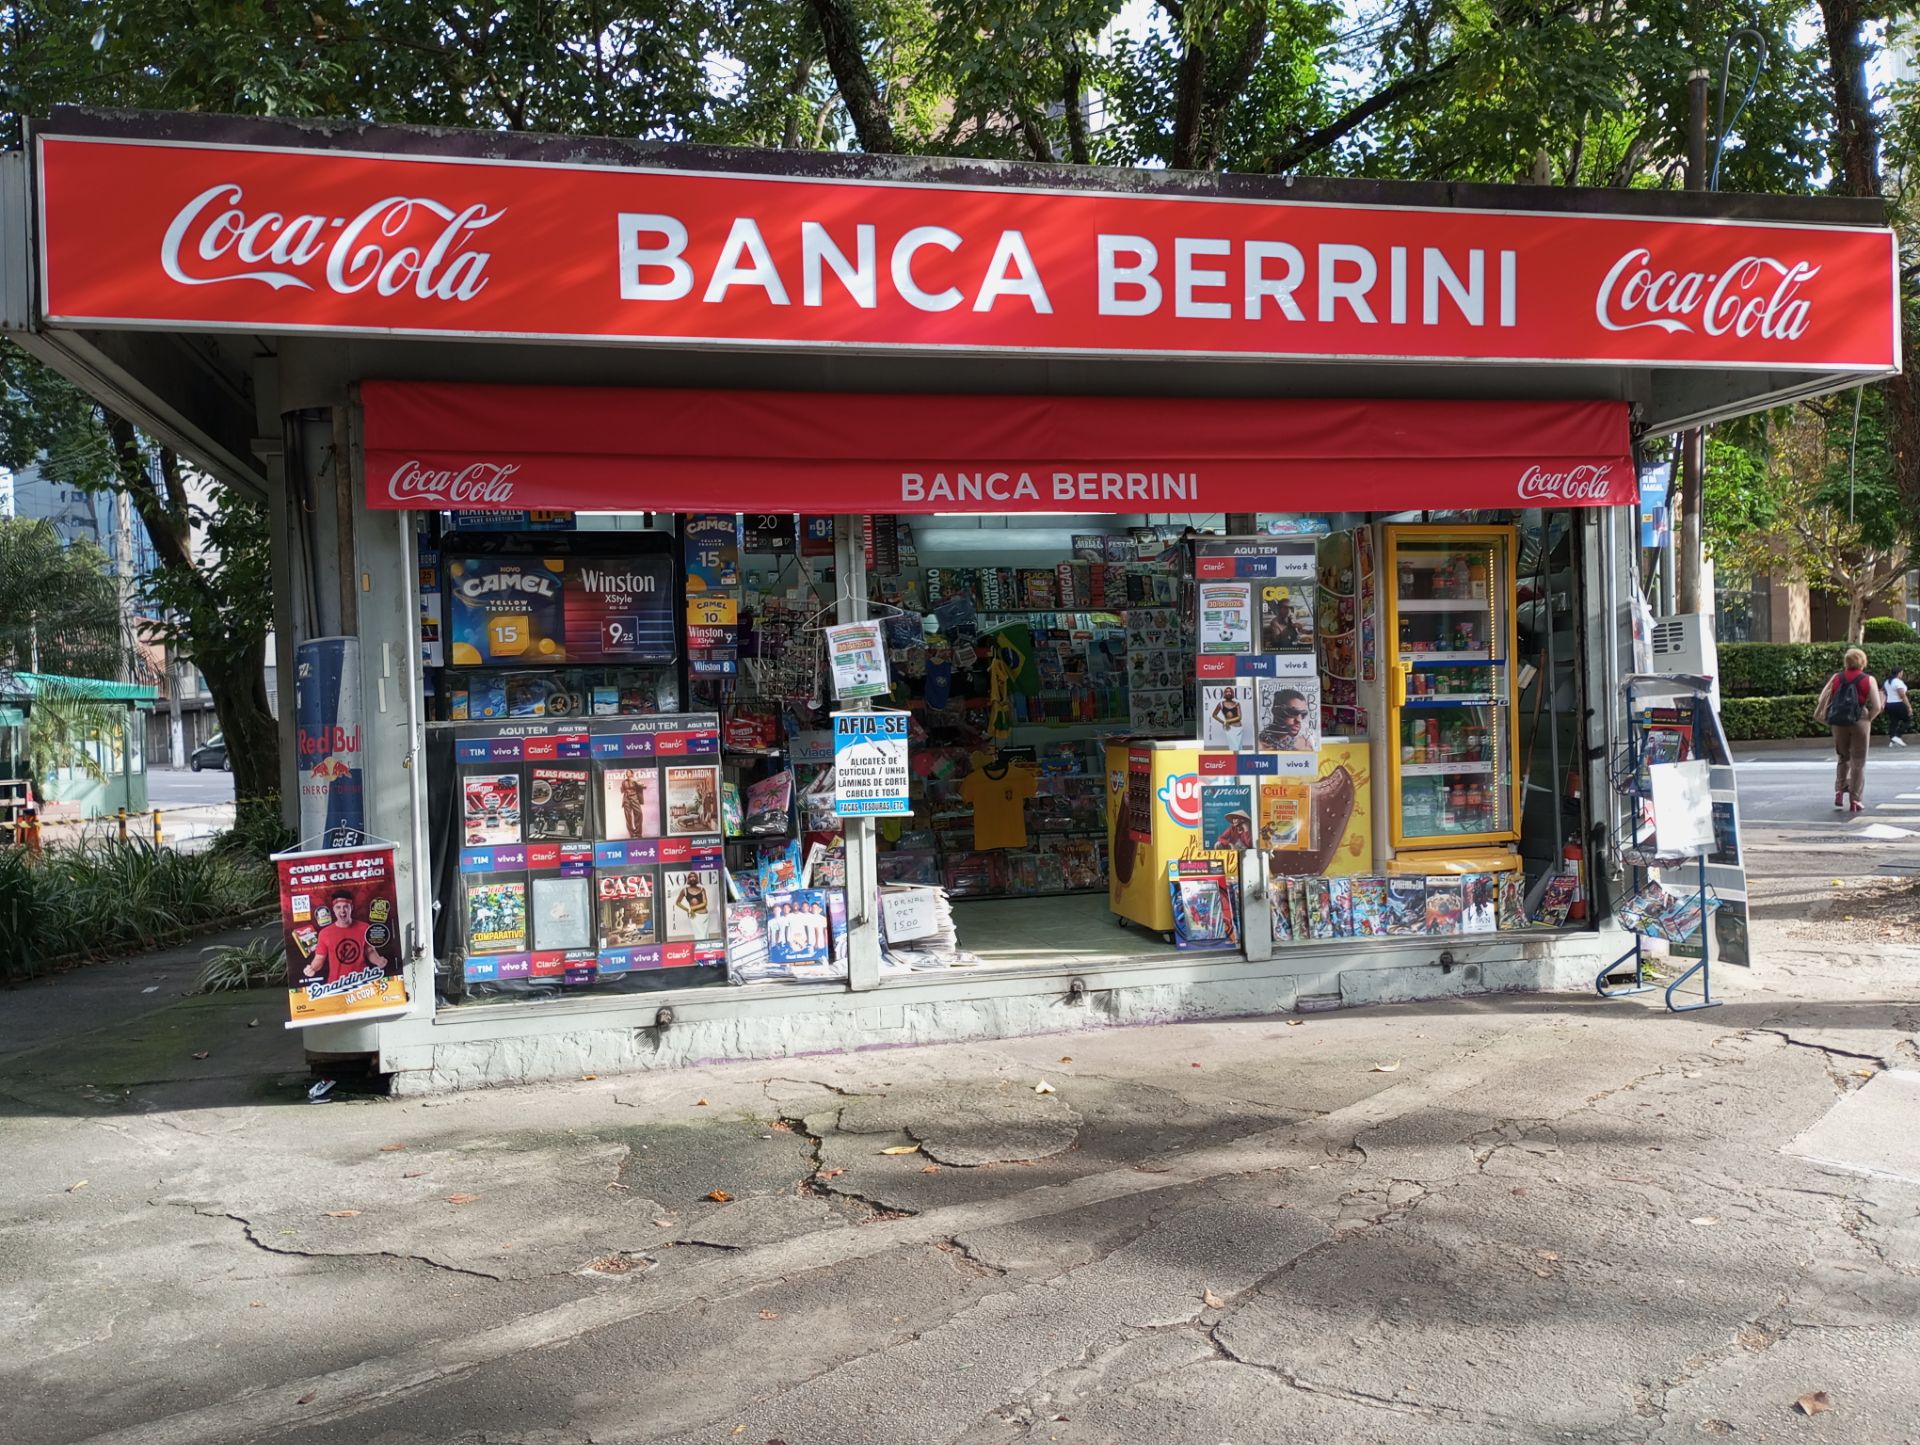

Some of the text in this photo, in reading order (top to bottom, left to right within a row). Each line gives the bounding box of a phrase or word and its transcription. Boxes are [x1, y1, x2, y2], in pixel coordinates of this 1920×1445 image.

[161, 184, 507, 301] Coca-Cola
[617, 212, 1518, 328] BANCA BERRINI
[1596, 247, 1821, 340] Coca-Cola
[388, 460, 521, 502] Coca-Cola
[901, 473, 1198, 501] BANCA BERRINI
[1518, 465, 1613, 499] Coca-Cola
[686, 519, 735, 534] CAMEL
[758, 515, 777, 529] 20
[463, 574, 554, 597] CAMEL
[581, 566, 655, 592] Winston
[605, 594, 632, 605] XStyle
[495, 626, 518, 642] 15
[688, 625, 723, 638] Winston
[1205, 687, 1252, 700] VOUE
[498, 726, 548, 736] AQUI TEM
[631, 722, 678, 731] AQUI TEM
[838, 716, 907, 734] AFIA-SE
[299, 723, 362, 755] Red Bull
[659, 741, 680, 749] Claro
[469, 748, 486, 756] TIM
[528, 745, 550, 754] Claro
[800, 748, 835, 757] Viage
[851, 757, 897, 766] ALICATES DE
[885, 767, 905, 775] UNHA
[838, 776, 872, 787] LÂMINAS
[885, 778, 907, 786] CORTE
[846, 789, 874, 798] CABELO
[882, 788, 900, 796] TOSA
[1263, 787, 1287, 797] Cult
[893, 801, 904, 809] ETC
[473, 856, 489, 864] TIM
[607, 851, 622, 859] TIM
[630, 849, 648, 857] vivo
[289, 858, 384, 874] COMPLETE AQUI
[290, 868, 385, 885] A SUA COLEÇÃO!
[667, 871, 719, 886] VOUE
[600, 876, 650, 897] CASA
[473, 930, 524, 941] COMPARATIVO
[611, 956, 626, 964] TIM
[634, 954, 652, 962] vivo
[477, 960, 557, 973] TIM vivo Claro
